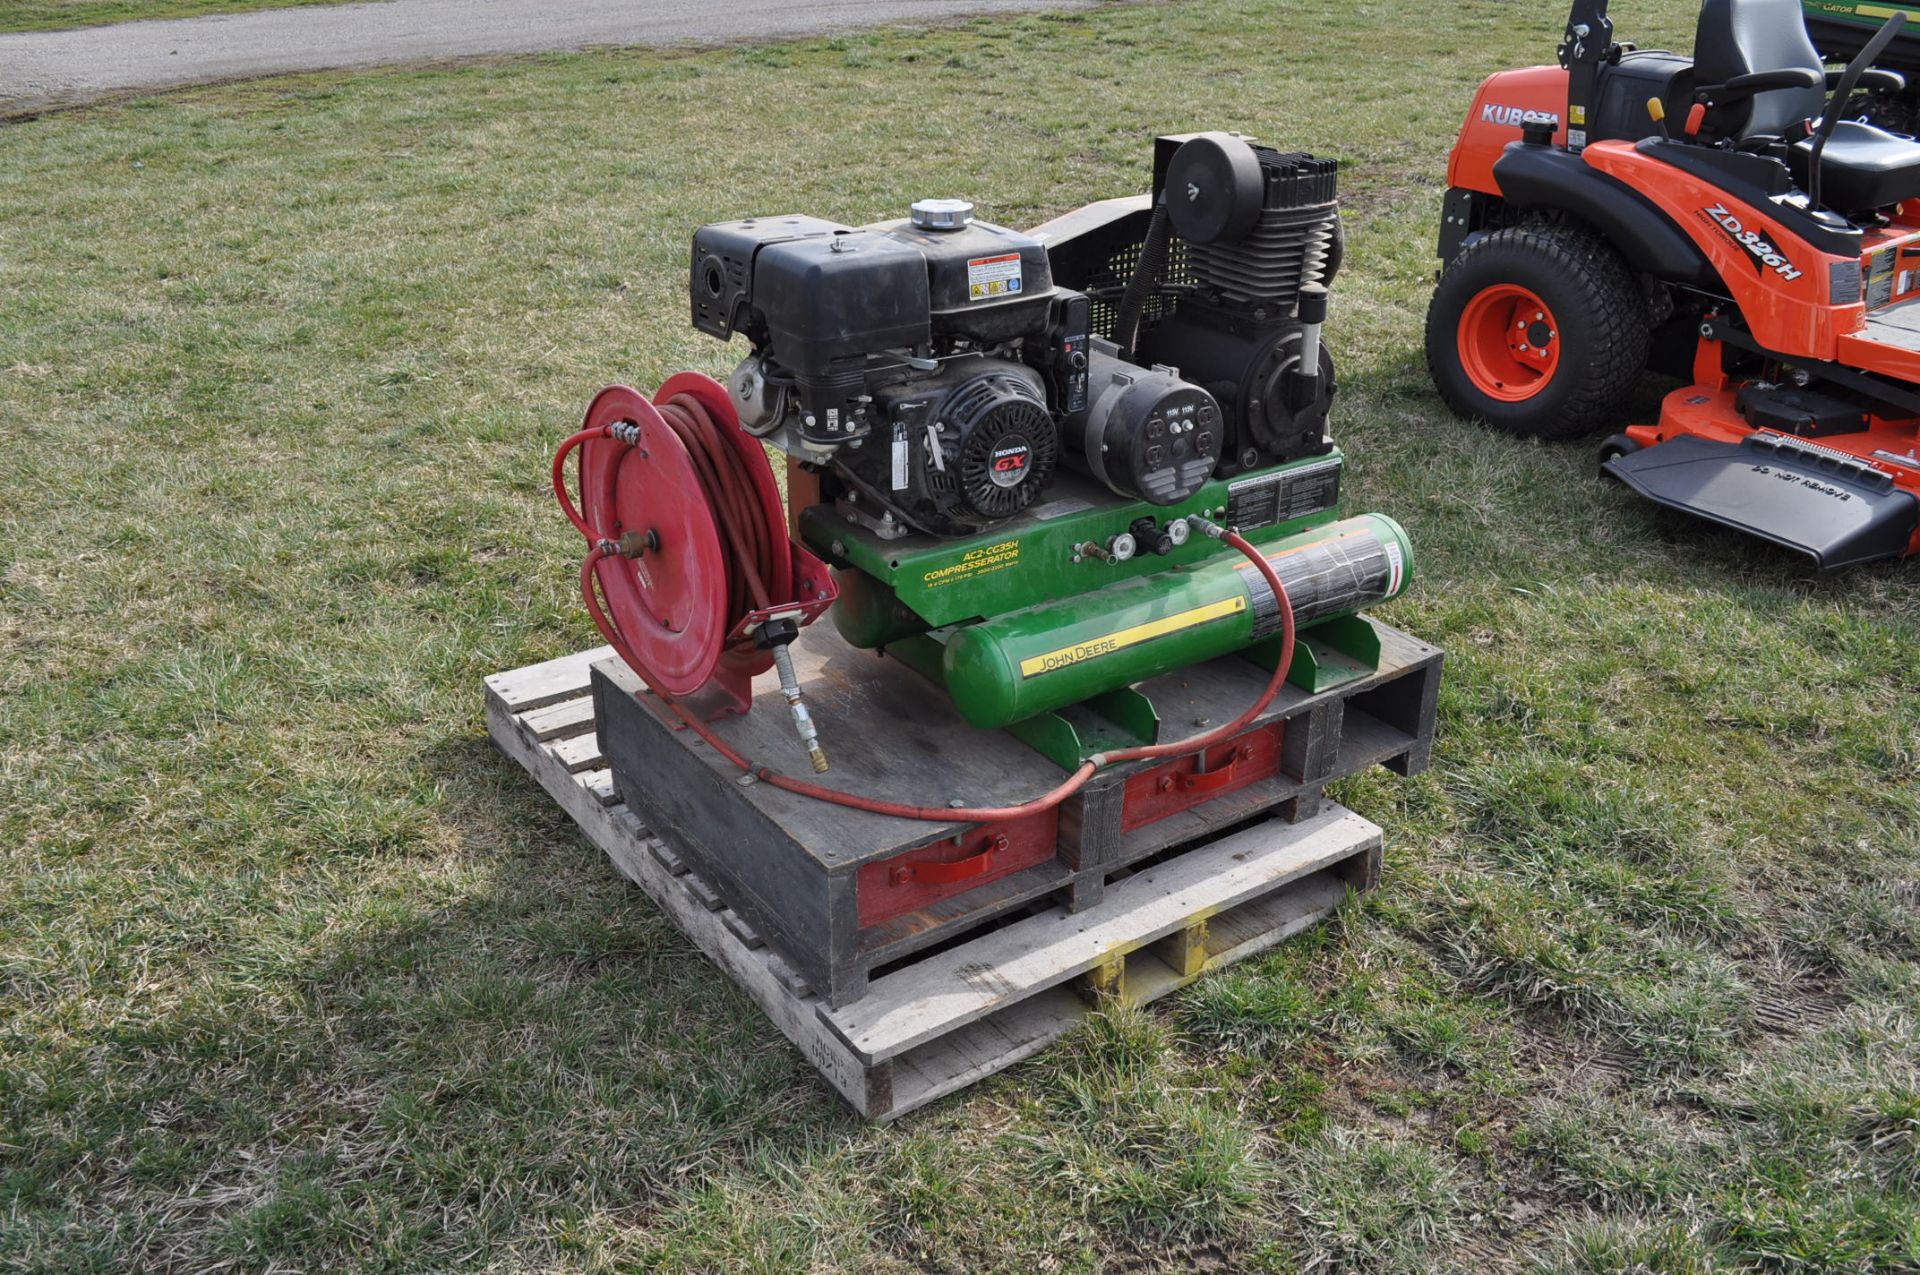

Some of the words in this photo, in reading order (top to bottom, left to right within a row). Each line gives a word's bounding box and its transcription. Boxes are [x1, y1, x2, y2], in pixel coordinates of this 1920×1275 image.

[1823, 3, 1853, 14] GATOR
[1702, 202, 1803, 281] ZD326H
[995, 445, 1028, 457] HONDA
[995, 454, 1025, 472] GX
[1752, 465, 1770, 475] DO
[1774, 472, 1800, 483] NOT
[1801, 479, 1852, 501] REMOVE
[924, 549, 1019, 581] COMPRESSERATOR
[1040, 651, 1074, 672] JOHN
[1075, 639, 1117, 660] DEERE
